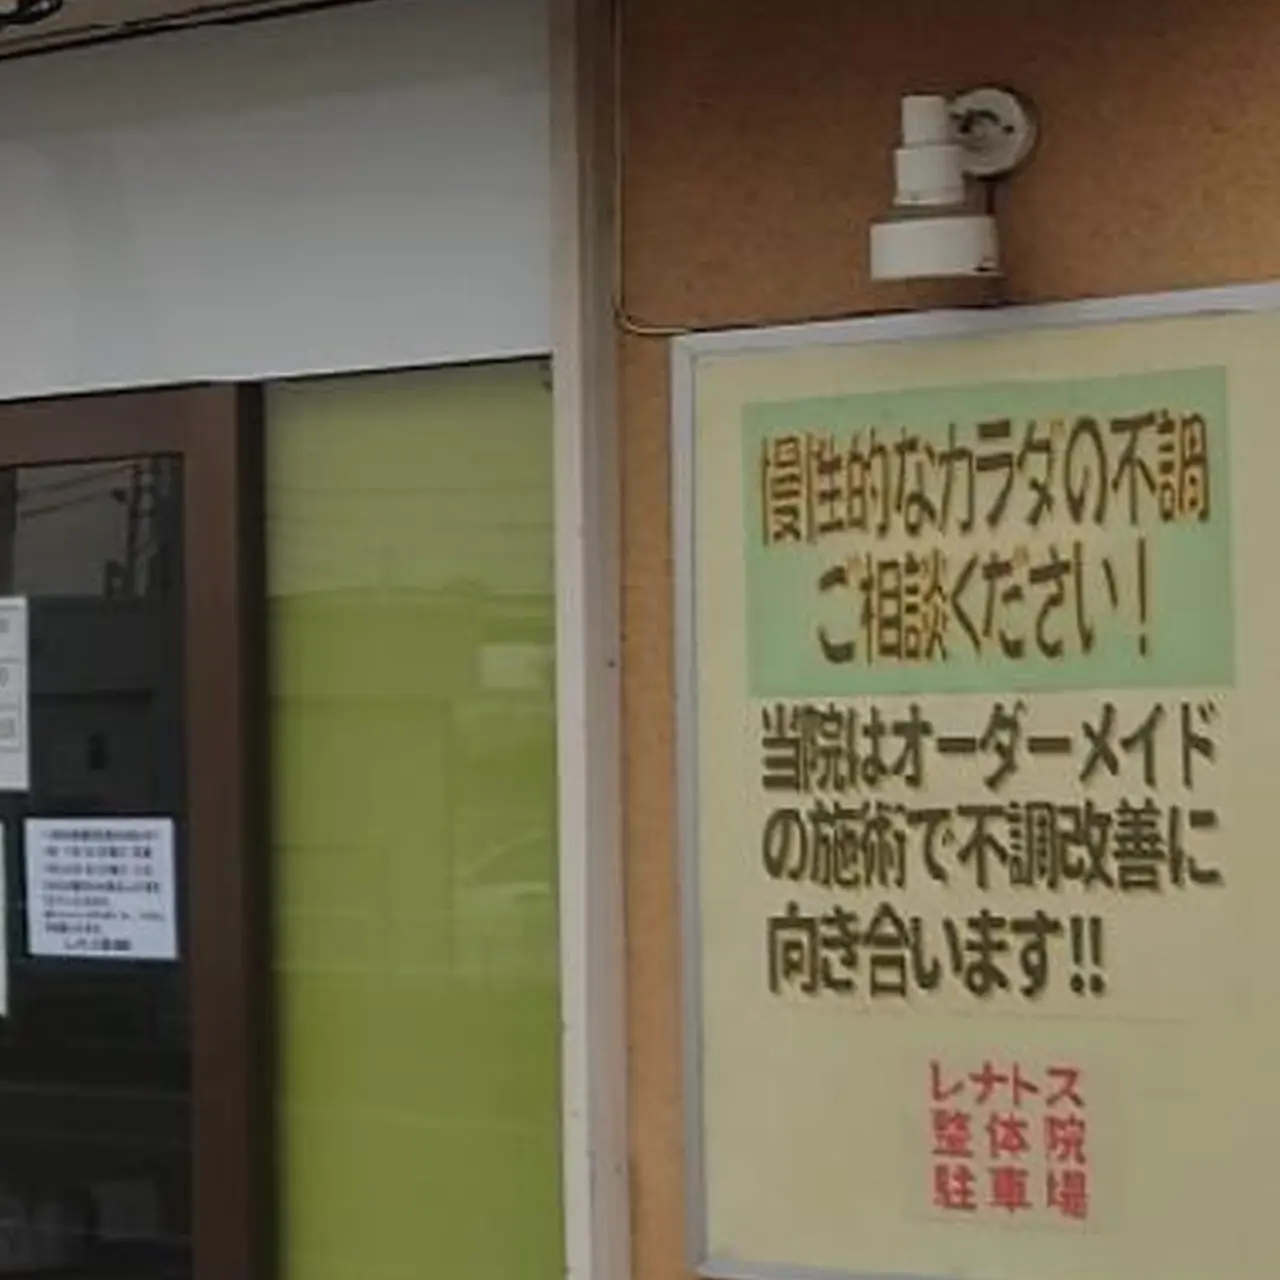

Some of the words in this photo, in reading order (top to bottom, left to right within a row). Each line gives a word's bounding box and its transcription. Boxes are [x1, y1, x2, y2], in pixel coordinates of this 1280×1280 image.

[762, 701, 1220, 793] 当院はオーダーメイド
[762, 798, 1226, 892] の施術で不調改善に
[930, 1059, 1087, 1107] レナトス
